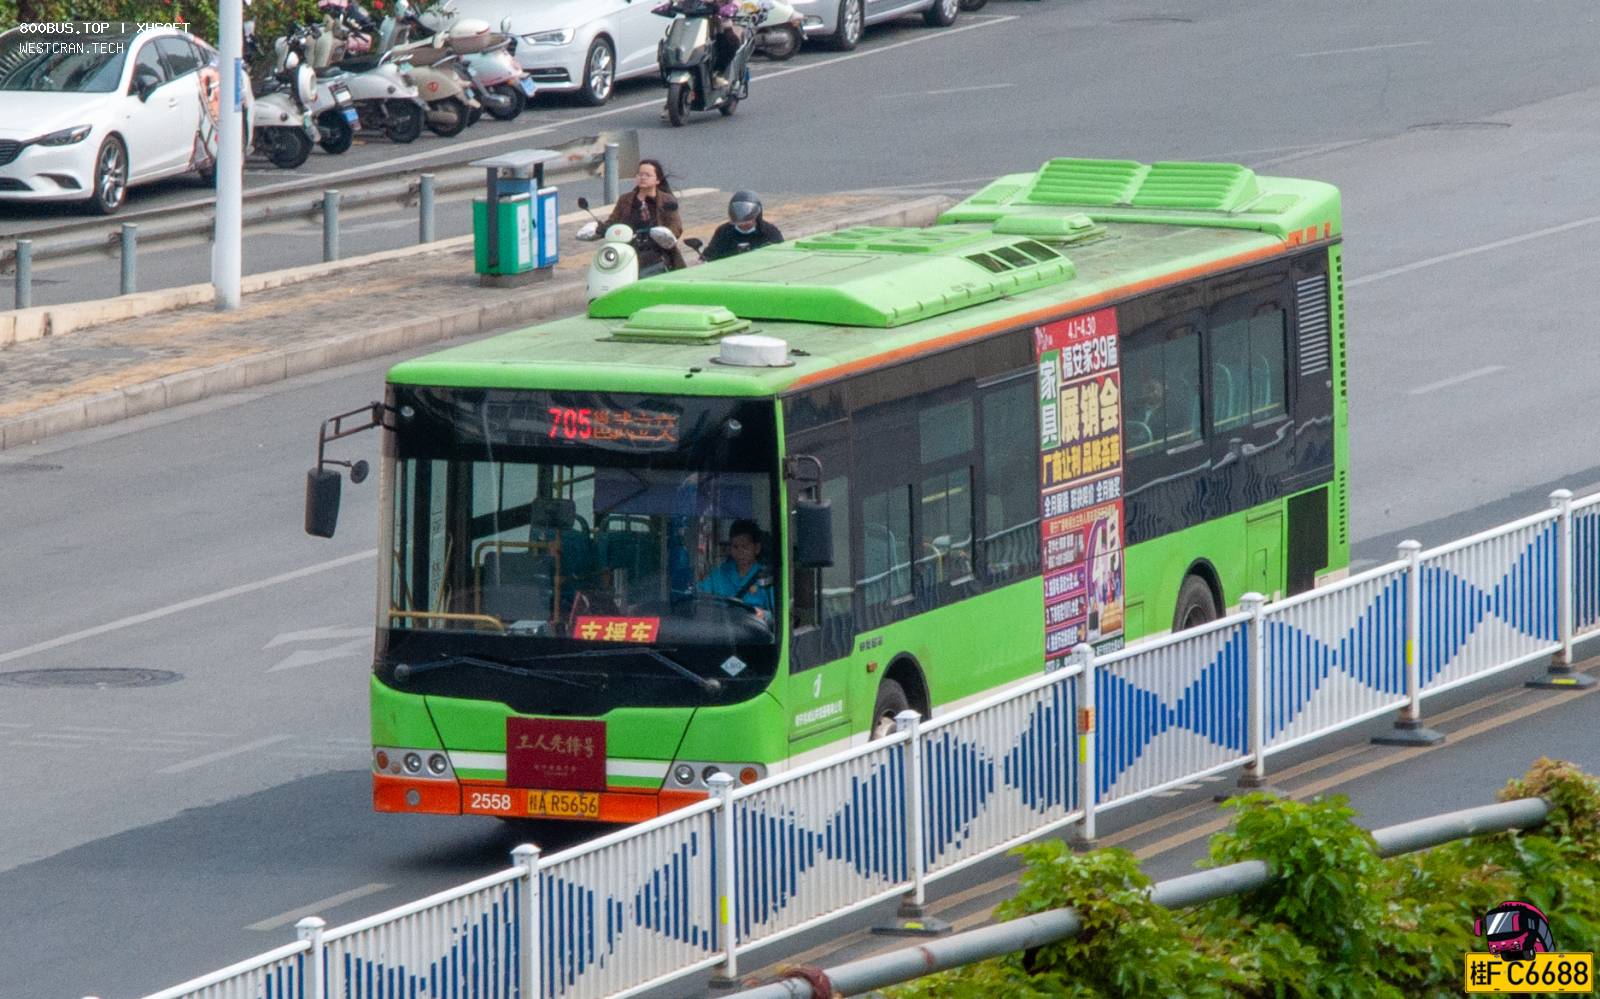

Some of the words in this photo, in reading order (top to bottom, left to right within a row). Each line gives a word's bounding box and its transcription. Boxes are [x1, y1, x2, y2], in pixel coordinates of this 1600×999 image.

[1068, 315, 1096, 339] 4.1-4.30
[1040, 360, 1058, 447] 家具
[1060, 377, 1119, 442] 展销会
[547, 407, 592, 439] 705
[592, 409, 679, 442] 邕武立交
[580, 620, 653, 641] 支援车
[514, 733, 595, 759] 工人先锋号
[471, 792, 512, 810] 2558
[551, 794, 598, 814] R5656
